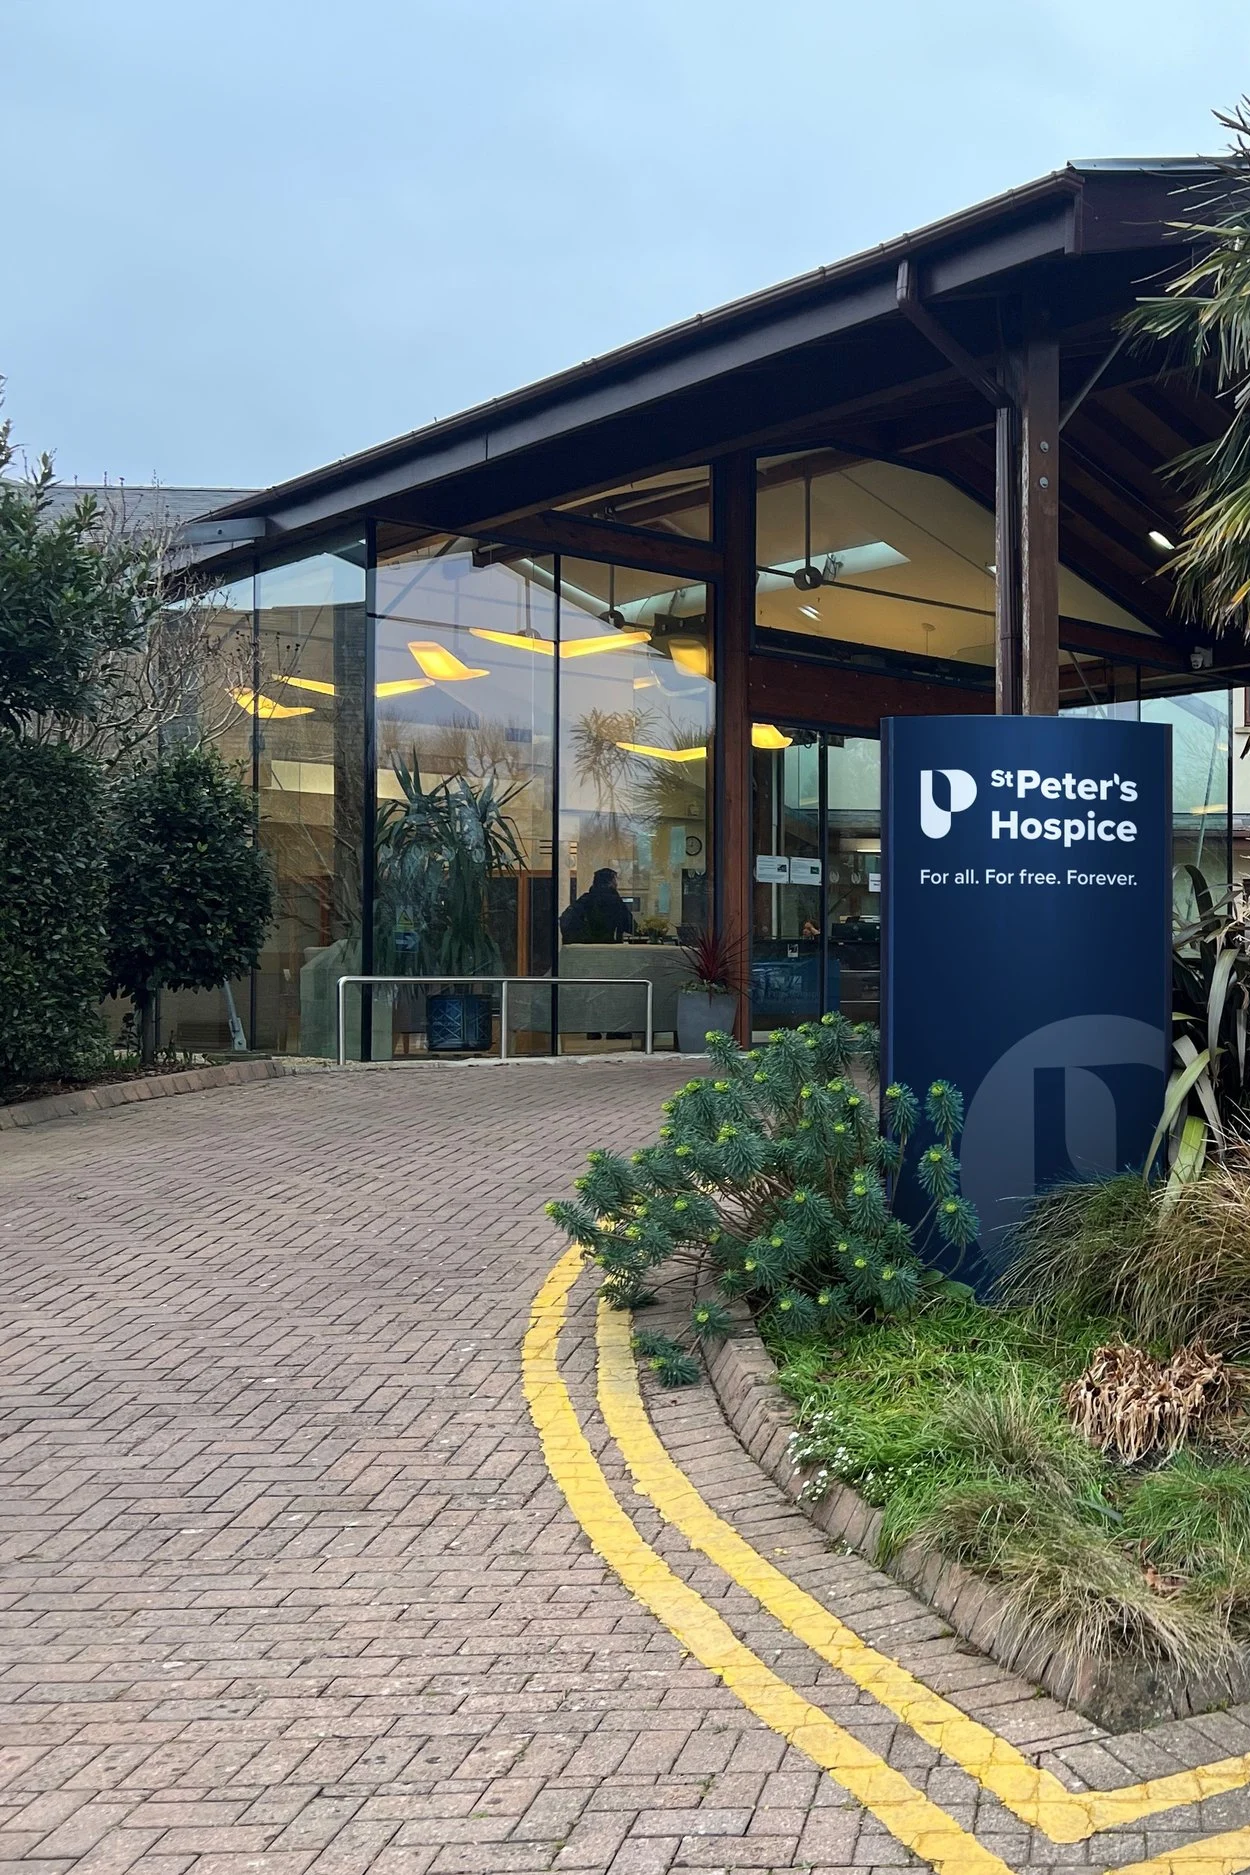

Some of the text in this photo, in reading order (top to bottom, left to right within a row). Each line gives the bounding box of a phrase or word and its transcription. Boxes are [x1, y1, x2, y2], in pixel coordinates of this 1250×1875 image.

[1016, 769, 1139, 802] Peter's
[991, 810, 1138, 848] Hospice
[920, 868, 1138, 886] For all. For free. Forever.
